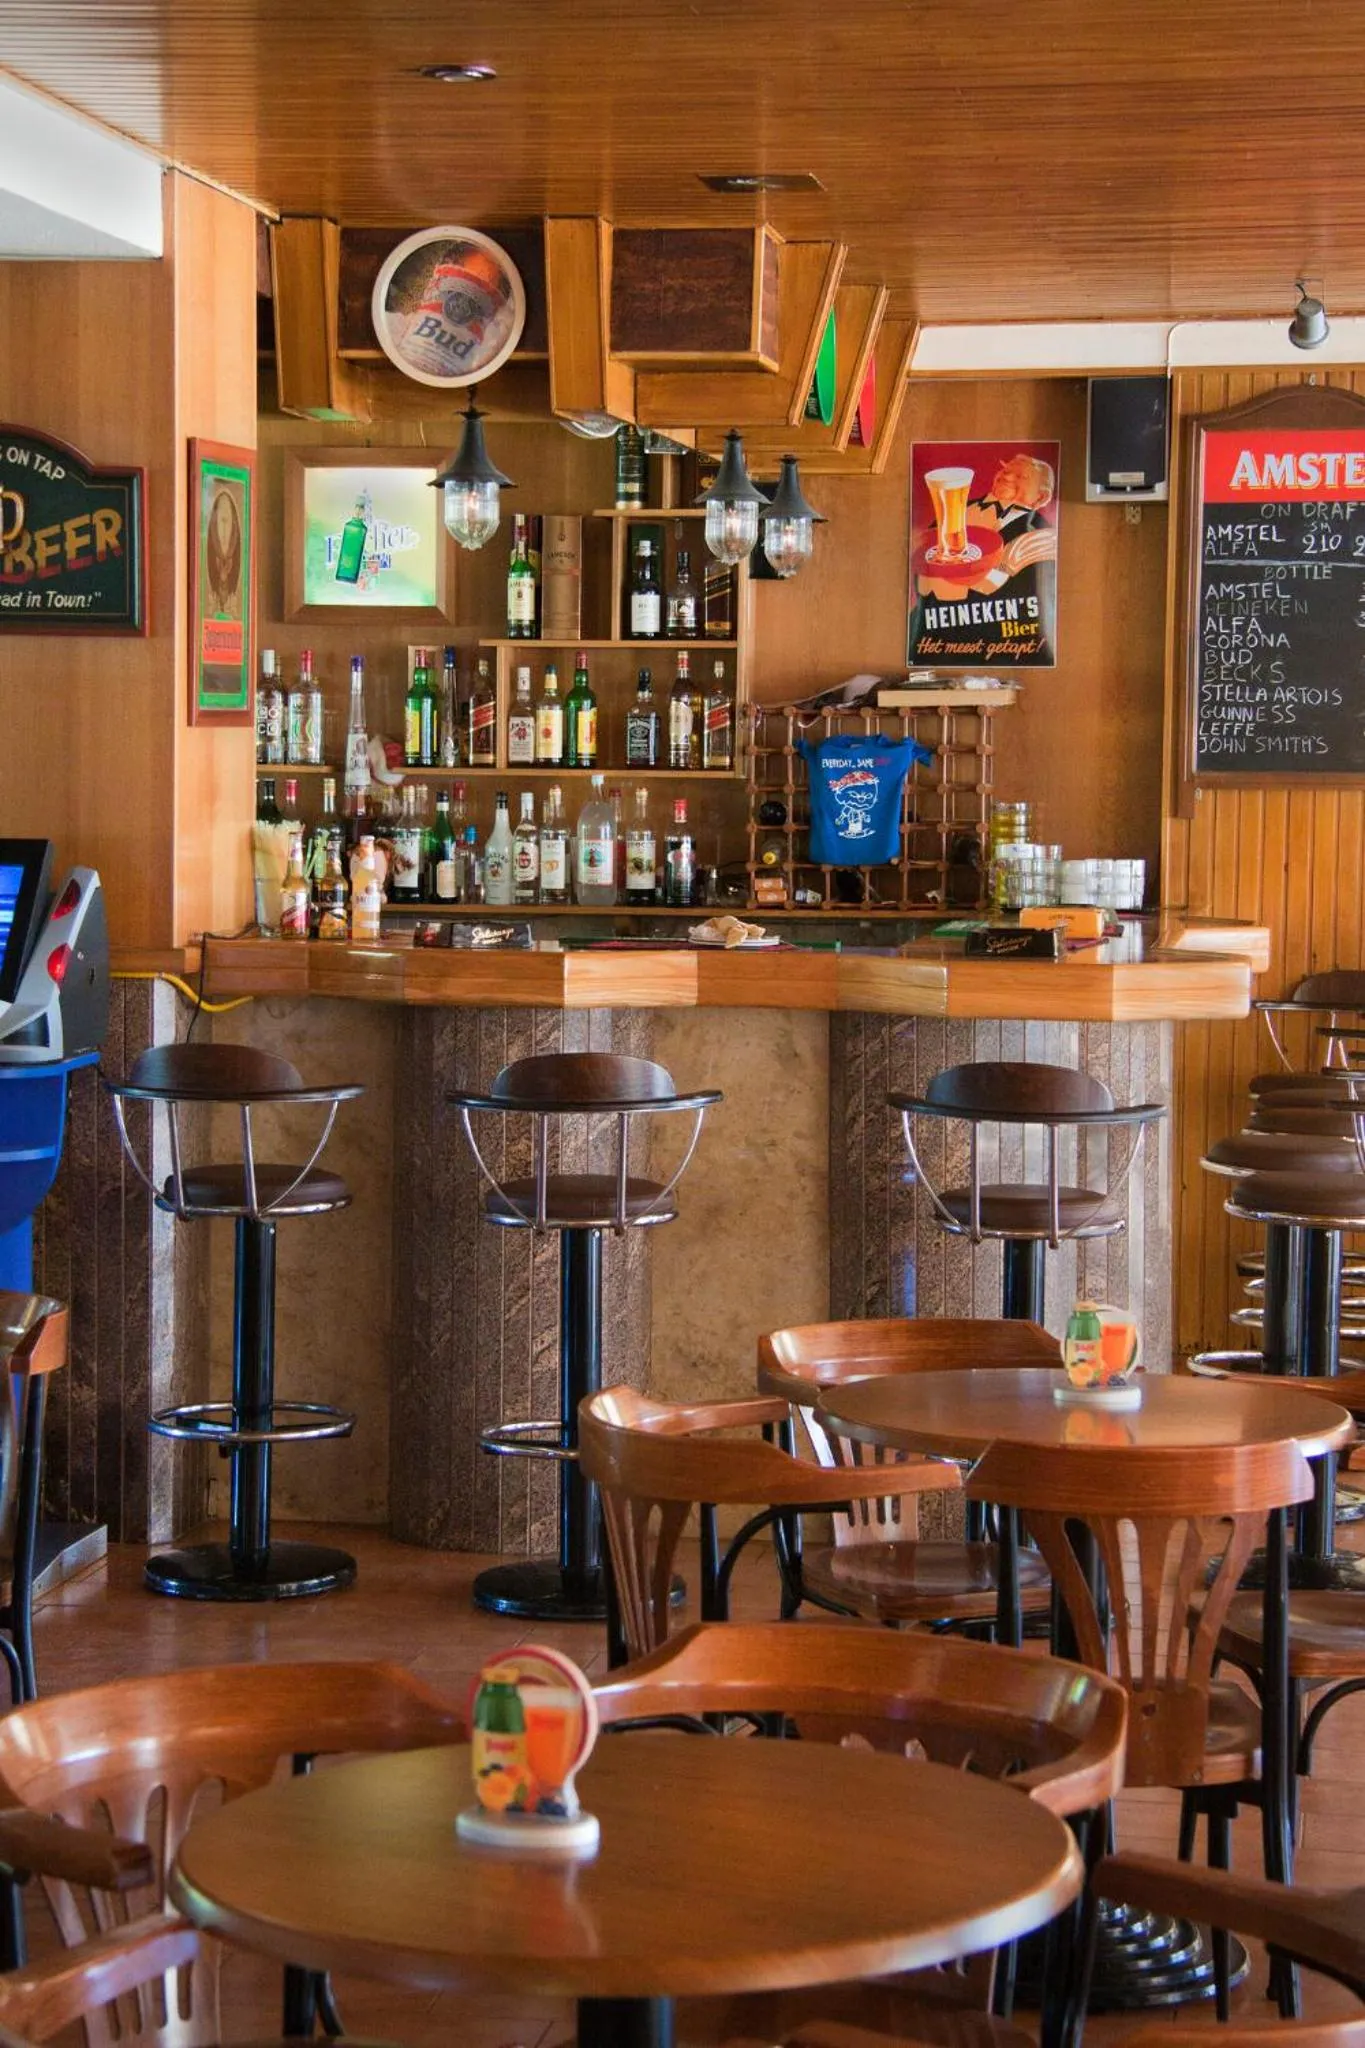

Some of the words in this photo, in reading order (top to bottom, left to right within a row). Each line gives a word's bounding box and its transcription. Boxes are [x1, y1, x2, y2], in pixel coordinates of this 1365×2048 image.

[413, 316, 476, 358] Bud
[6, 447, 31, 466] ON
[32, 454, 66, 480] TAP
[1229, 450, 1365, 490] AMSTE
[1261, 503, 1291, 519] ON
[1206, 524, 1286, 543] AMSTEL
[1302, 534, 1343, 554] 210
[1205, 541, 1258, 556] ALFA
[1264, 564, 1333, 581] BOTTLE
[0, 591, 23, 608] ad
[25, 590, 43, 608] in
[1204, 582, 1292, 601] AMSTEL
[925, 597, 1039, 628] HEINEKEN'S
[1205, 600, 1309, 617] HEINEKEN
[1001, 622, 1039, 639] Bier
[1203, 616, 1262, 636] ALFA
[917, 638, 942, 653] Het
[945, 642, 983, 655] meest
[1204, 633, 1291, 650] CORONA
[1204, 649, 1253, 665] BUD
[1200, 684, 1268, 703] STELLA
[1273, 686, 1343, 706] ARTOIS
[1200, 704, 1296, 723] GUINNESS
[1199, 722, 1256, 737] LEFFE
[1199, 736, 1246, 754] JOHN
[1255, 736, 1329, 755] SMITH'S
